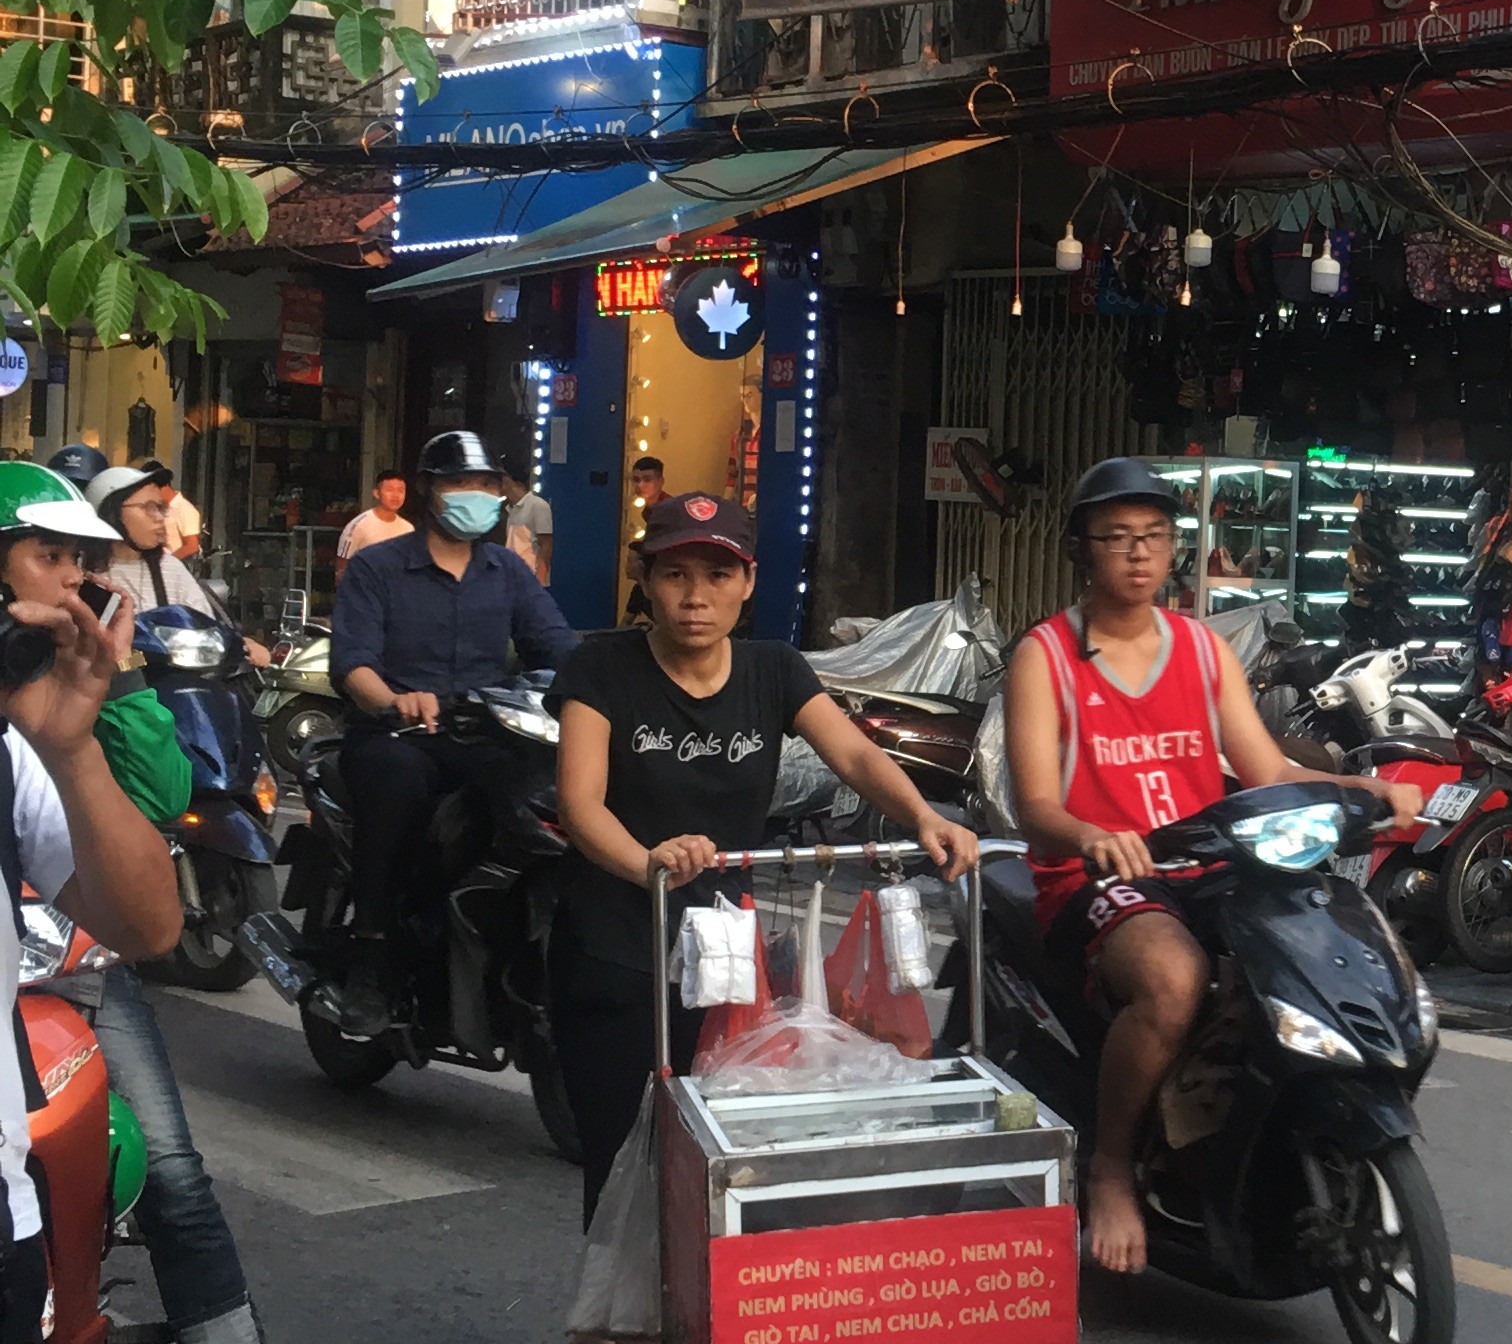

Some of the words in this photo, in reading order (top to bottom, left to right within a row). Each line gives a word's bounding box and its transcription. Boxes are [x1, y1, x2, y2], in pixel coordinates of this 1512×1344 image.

[632, 724, 674, 754] Girls
[677, 730, 723, 762] Girls
[728, 728, 764, 763] Girls
[1093, 730, 1204, 766] ROCKETS
[1135, 770, 1180, 829] 13
[738, 1257, 820, 1286] CHUYÊN
[837, 1253, 884, 1275] NEM
[889, 1248, 945, 1271] CHẠO
[961, 1242, 1007, 1263] NEM
[1011, 1239, 1043, 1258] TAI
[738, 1296, 785, 1317] NEM
[791, 1286, 864, 1312] PHÙNG
[880, 1278, 917, 1302] GIÒ
[921, 1280, 960, 1301] LỤA
[976, 1269, 1012, 1293] GIÒ
[1017, 1266, 1045, 1289] BÒ
[835, 1318, 882, 1339] NEM
[887, 1312, 943, 1332] CHUA
[959, 1299, 999, 1326] CHẢ
[1004, 1296, 1051, 1321] CỐM
